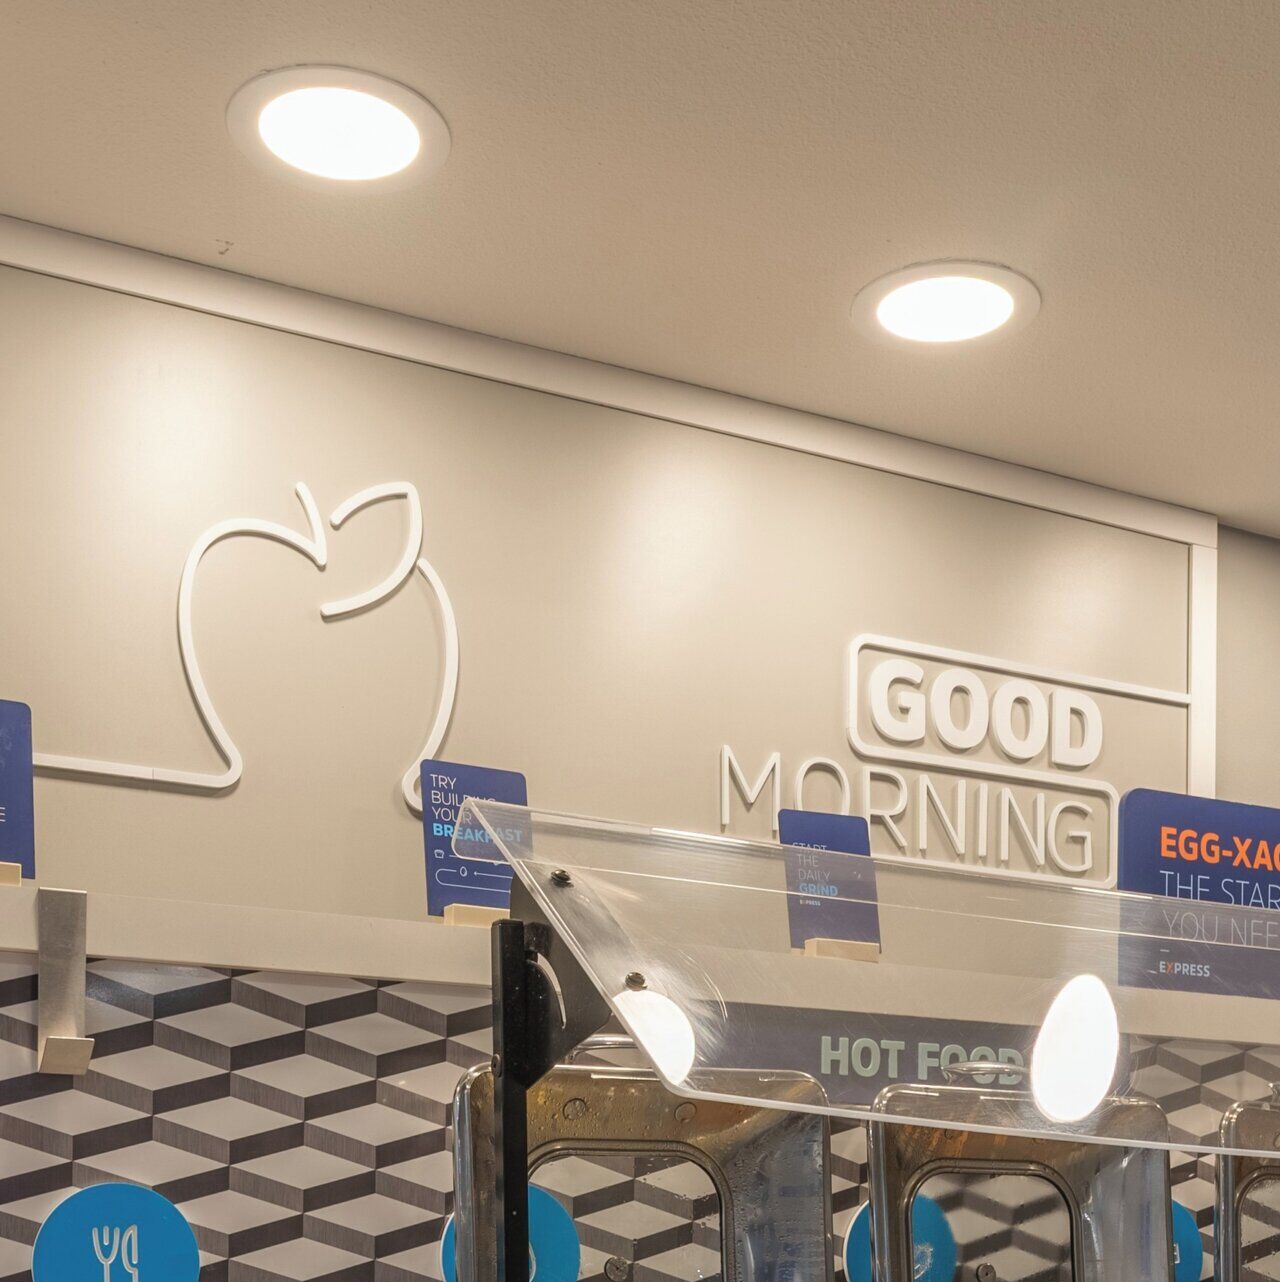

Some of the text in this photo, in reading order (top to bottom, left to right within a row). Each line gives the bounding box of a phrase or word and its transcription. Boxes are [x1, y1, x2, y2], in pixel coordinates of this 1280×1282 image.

[869, 658, 1103, 768] GOOD
[430, 773, 457, 790] TRY
[431, 806, 472, 825] YOUR
[720, 745, 1095, 873] MORNING
[432, 822, 523, 844] BREAKFAST
[799, 882, 839, 897] GRIND
[1159, 869, 1211, 901] THE
[1162, 909, 1219, 943] YOU
[1159, 961, 1211, 977] EXPRESS
[821, 1036, 1024, 1086] HOT FOOD
